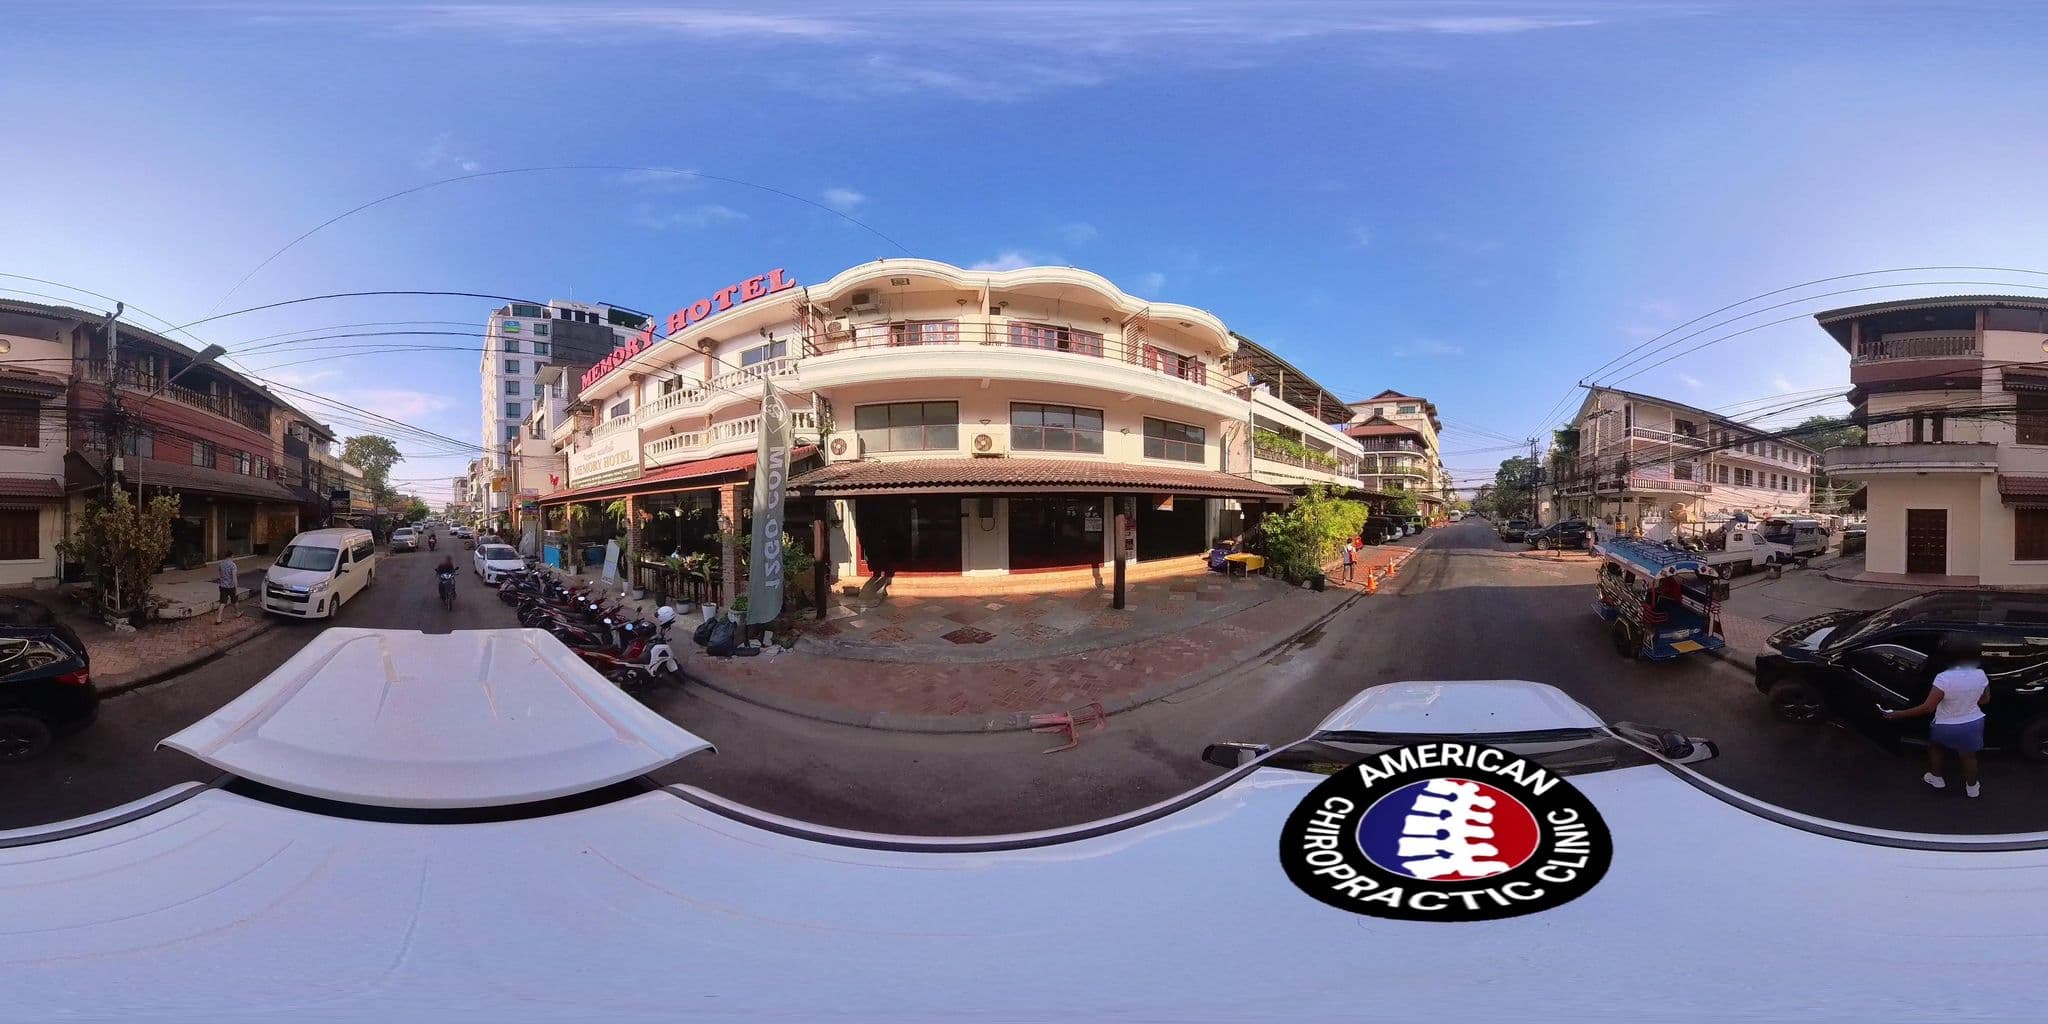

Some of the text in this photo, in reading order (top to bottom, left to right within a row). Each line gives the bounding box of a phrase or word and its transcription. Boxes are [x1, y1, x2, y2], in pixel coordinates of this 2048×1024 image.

[581, 268, 796, 391] MEMORY HOTEL
[604, 449, 633, 468] HOTEL
